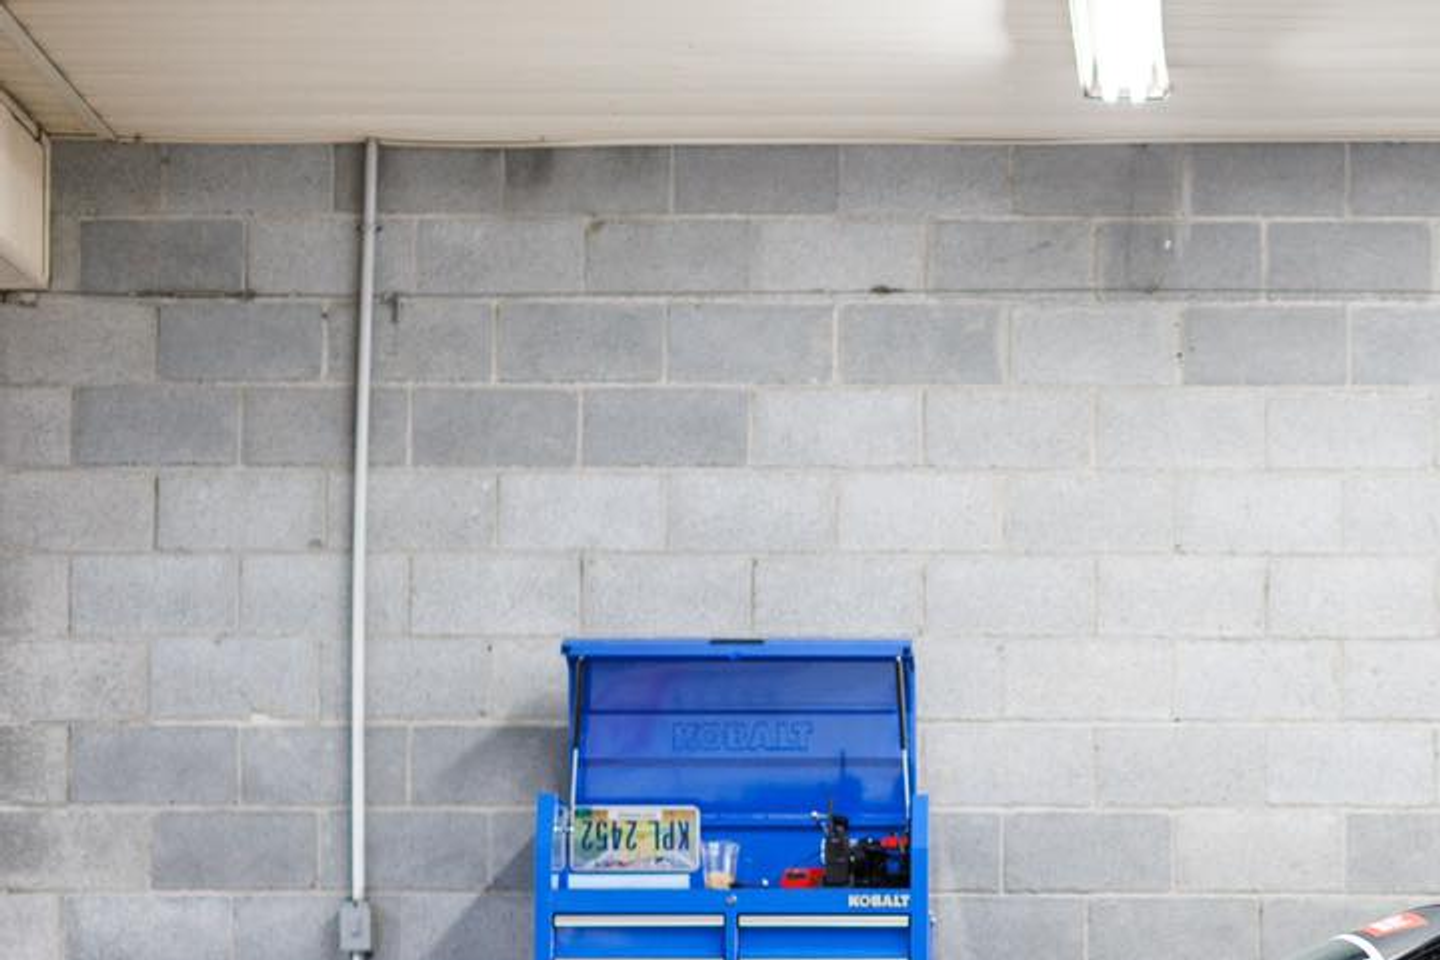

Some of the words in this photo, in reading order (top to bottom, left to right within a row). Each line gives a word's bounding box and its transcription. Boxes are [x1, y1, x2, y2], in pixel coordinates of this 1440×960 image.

[672, 721, 813, 753] KOBALT
[581, 820, 637, 851] 2452
[649, 820, 689, 851] KPL
[848, 894, 911, 908] KOBALT
